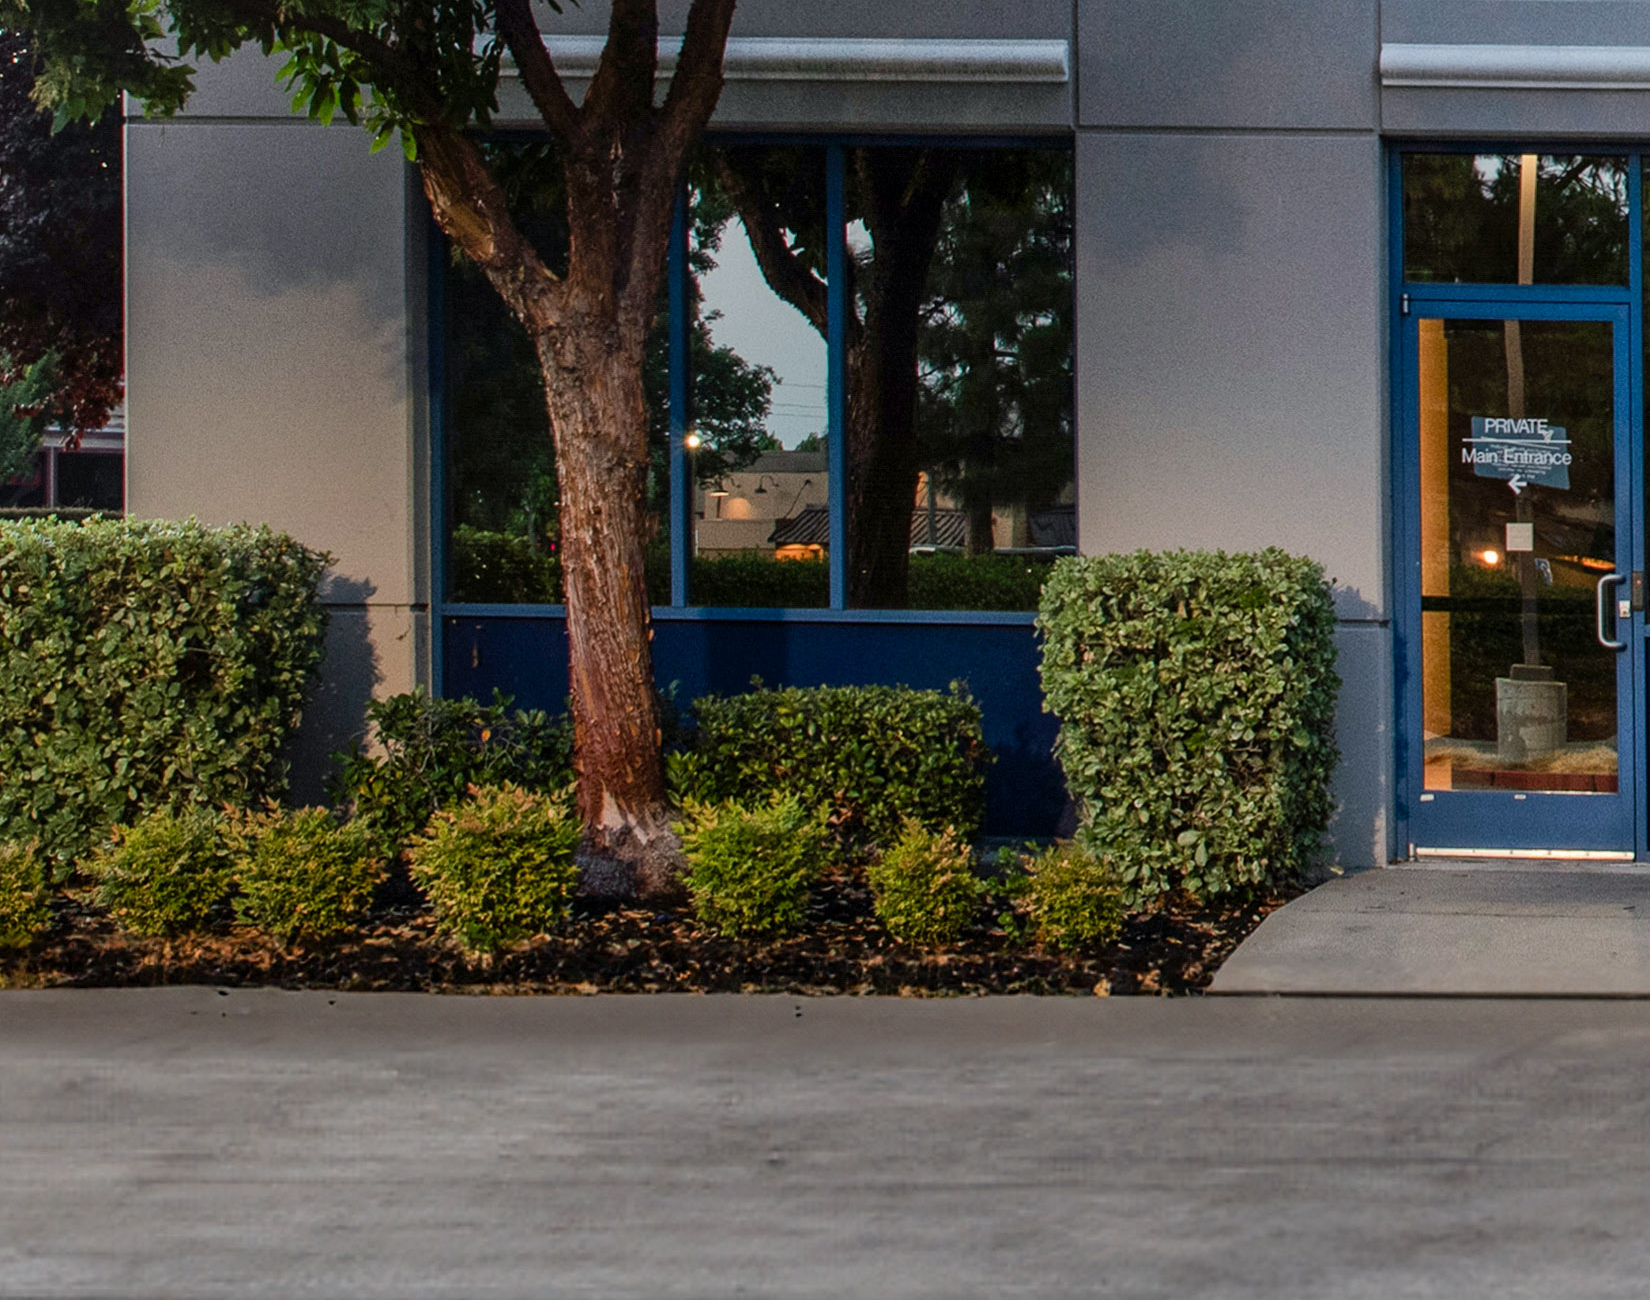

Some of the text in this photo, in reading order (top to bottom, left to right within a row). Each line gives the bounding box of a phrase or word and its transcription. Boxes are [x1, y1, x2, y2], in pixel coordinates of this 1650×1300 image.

[1484, 418, 1549, 434] PRIVATE
[1462, 448, 1498, 464] Main
[1503, 448, 1572, 466] Entrance
